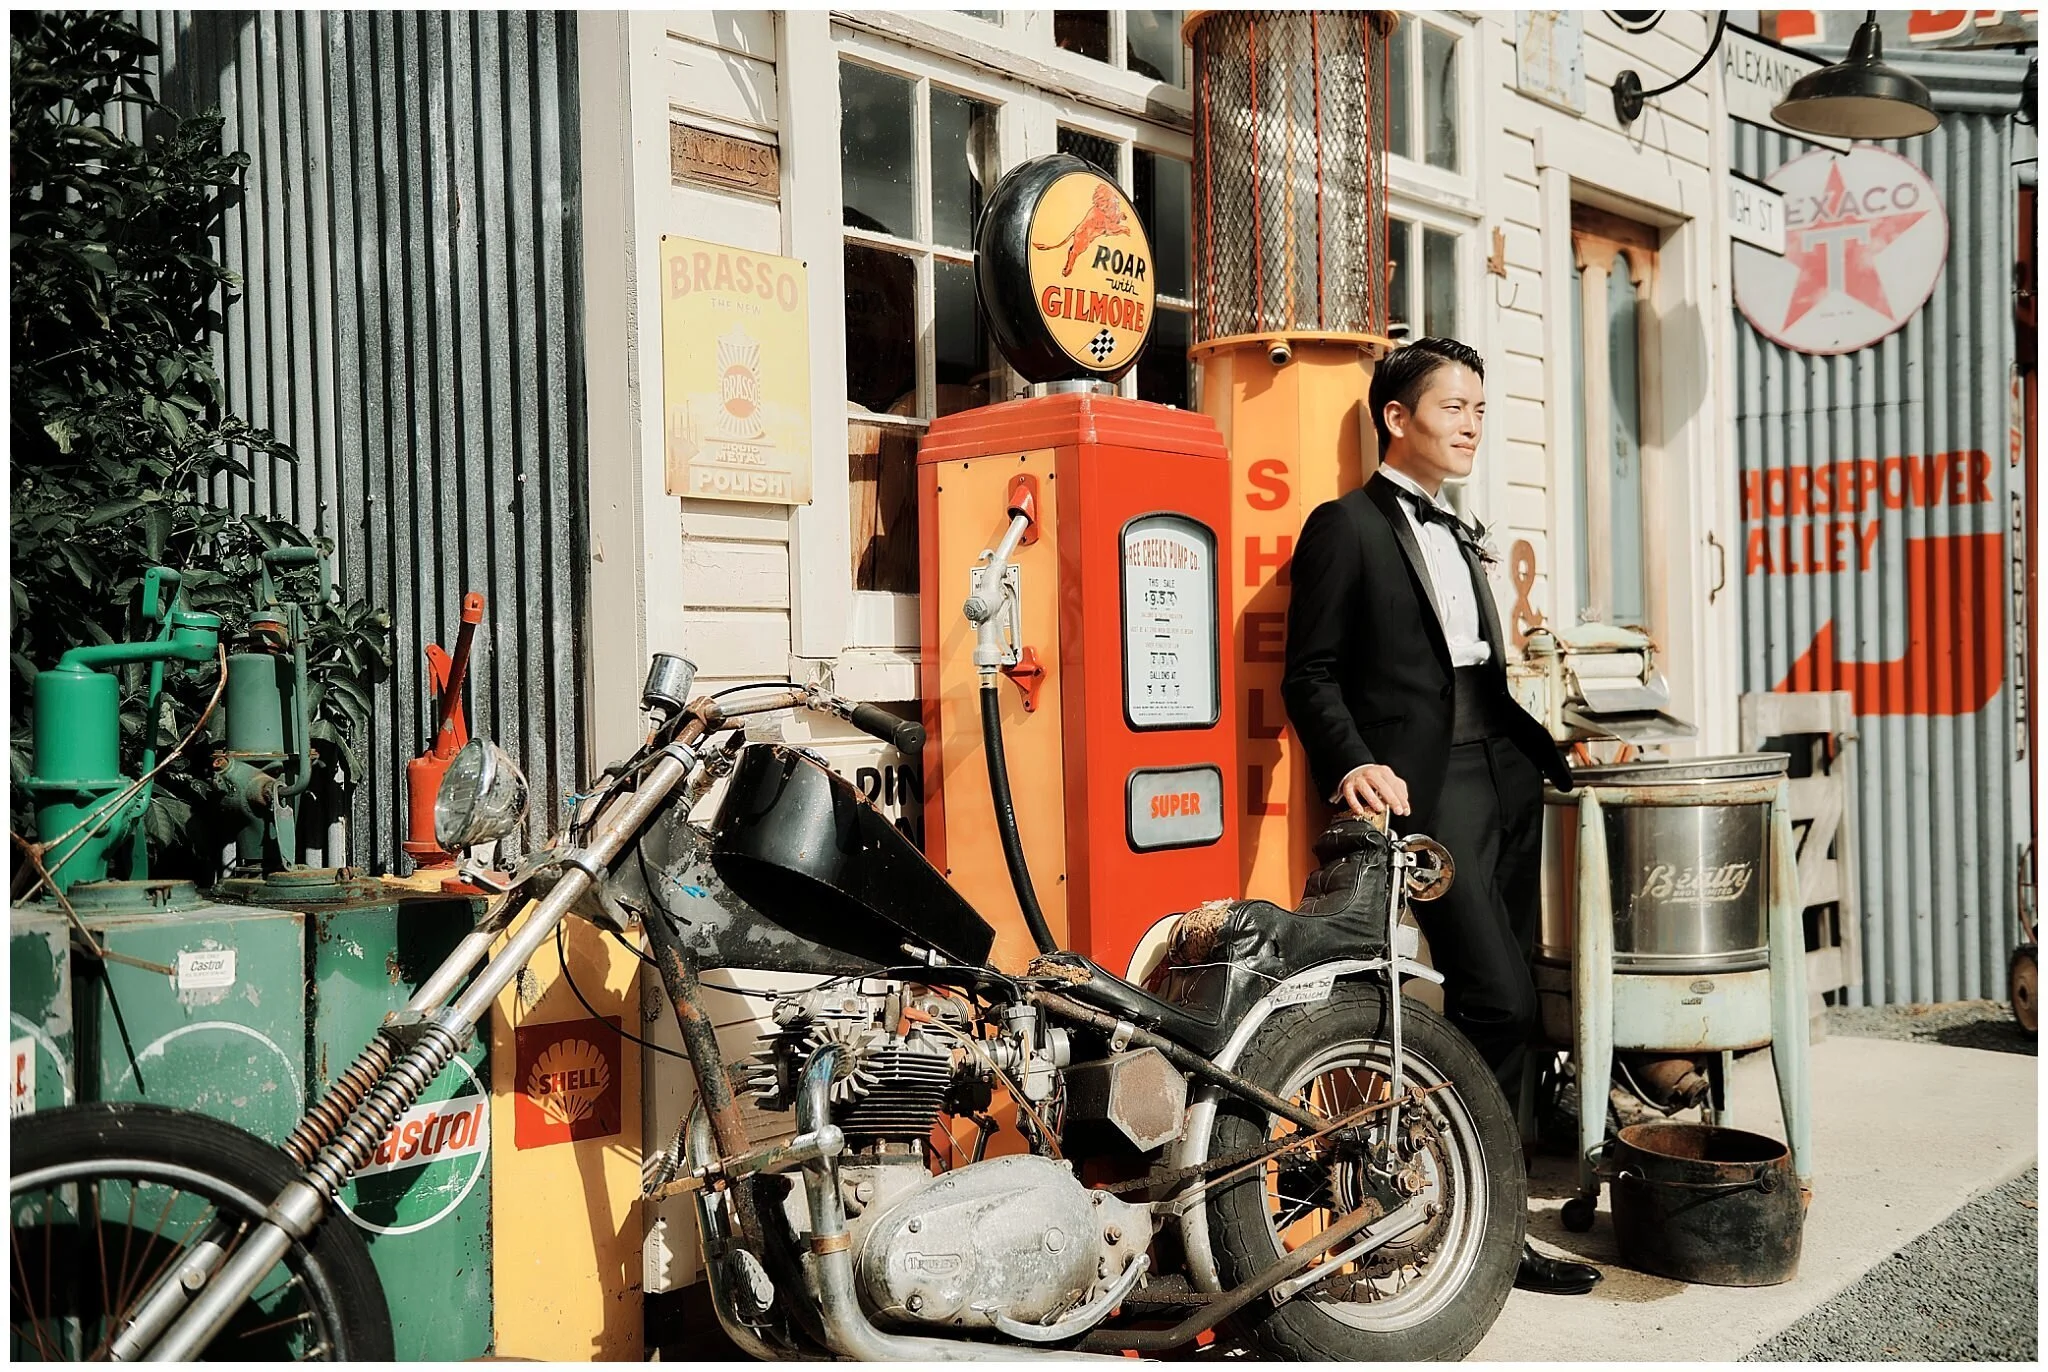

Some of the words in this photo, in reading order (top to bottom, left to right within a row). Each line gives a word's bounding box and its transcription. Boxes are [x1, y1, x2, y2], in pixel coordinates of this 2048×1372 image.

[1759, 199, 1773, 235] ST
[1092, 245, 1146, 282] ROAR
[669, 252, 799, 312] BRASSO
[1106, 278, 1139, 296] with
[711, 297, 731, 308] THE
[736, 302, 762, 315] NEW
[1042, 286, 1144, 333] GILMORE
[722, 374, 759, 407] BRASSO
[716, 451, 767, 466] METAL
[721, 442, 760, 454] LIQUID
[700, 470, 787, 497] POLISH
[1739, 449, 1994, 523] HORSEPOWER
[1143, 539, 1167, 568] CREEKS
[1169, 541, 1188, 569] PUMP
[1745, 519, 1881, 576] ALLEY
[1243, 459, 1293, 816] SHELL
[1151, 792, 1201, 819] SUPER
[1640, 861, 1753, 899] Beauty
[1700, 887, 1733, 896] IMITED
[190, 959, 225, 972] Castrol
[539, 1067, 601, 1095] SHELL
[355, 1103, 484, 1170] astrol
